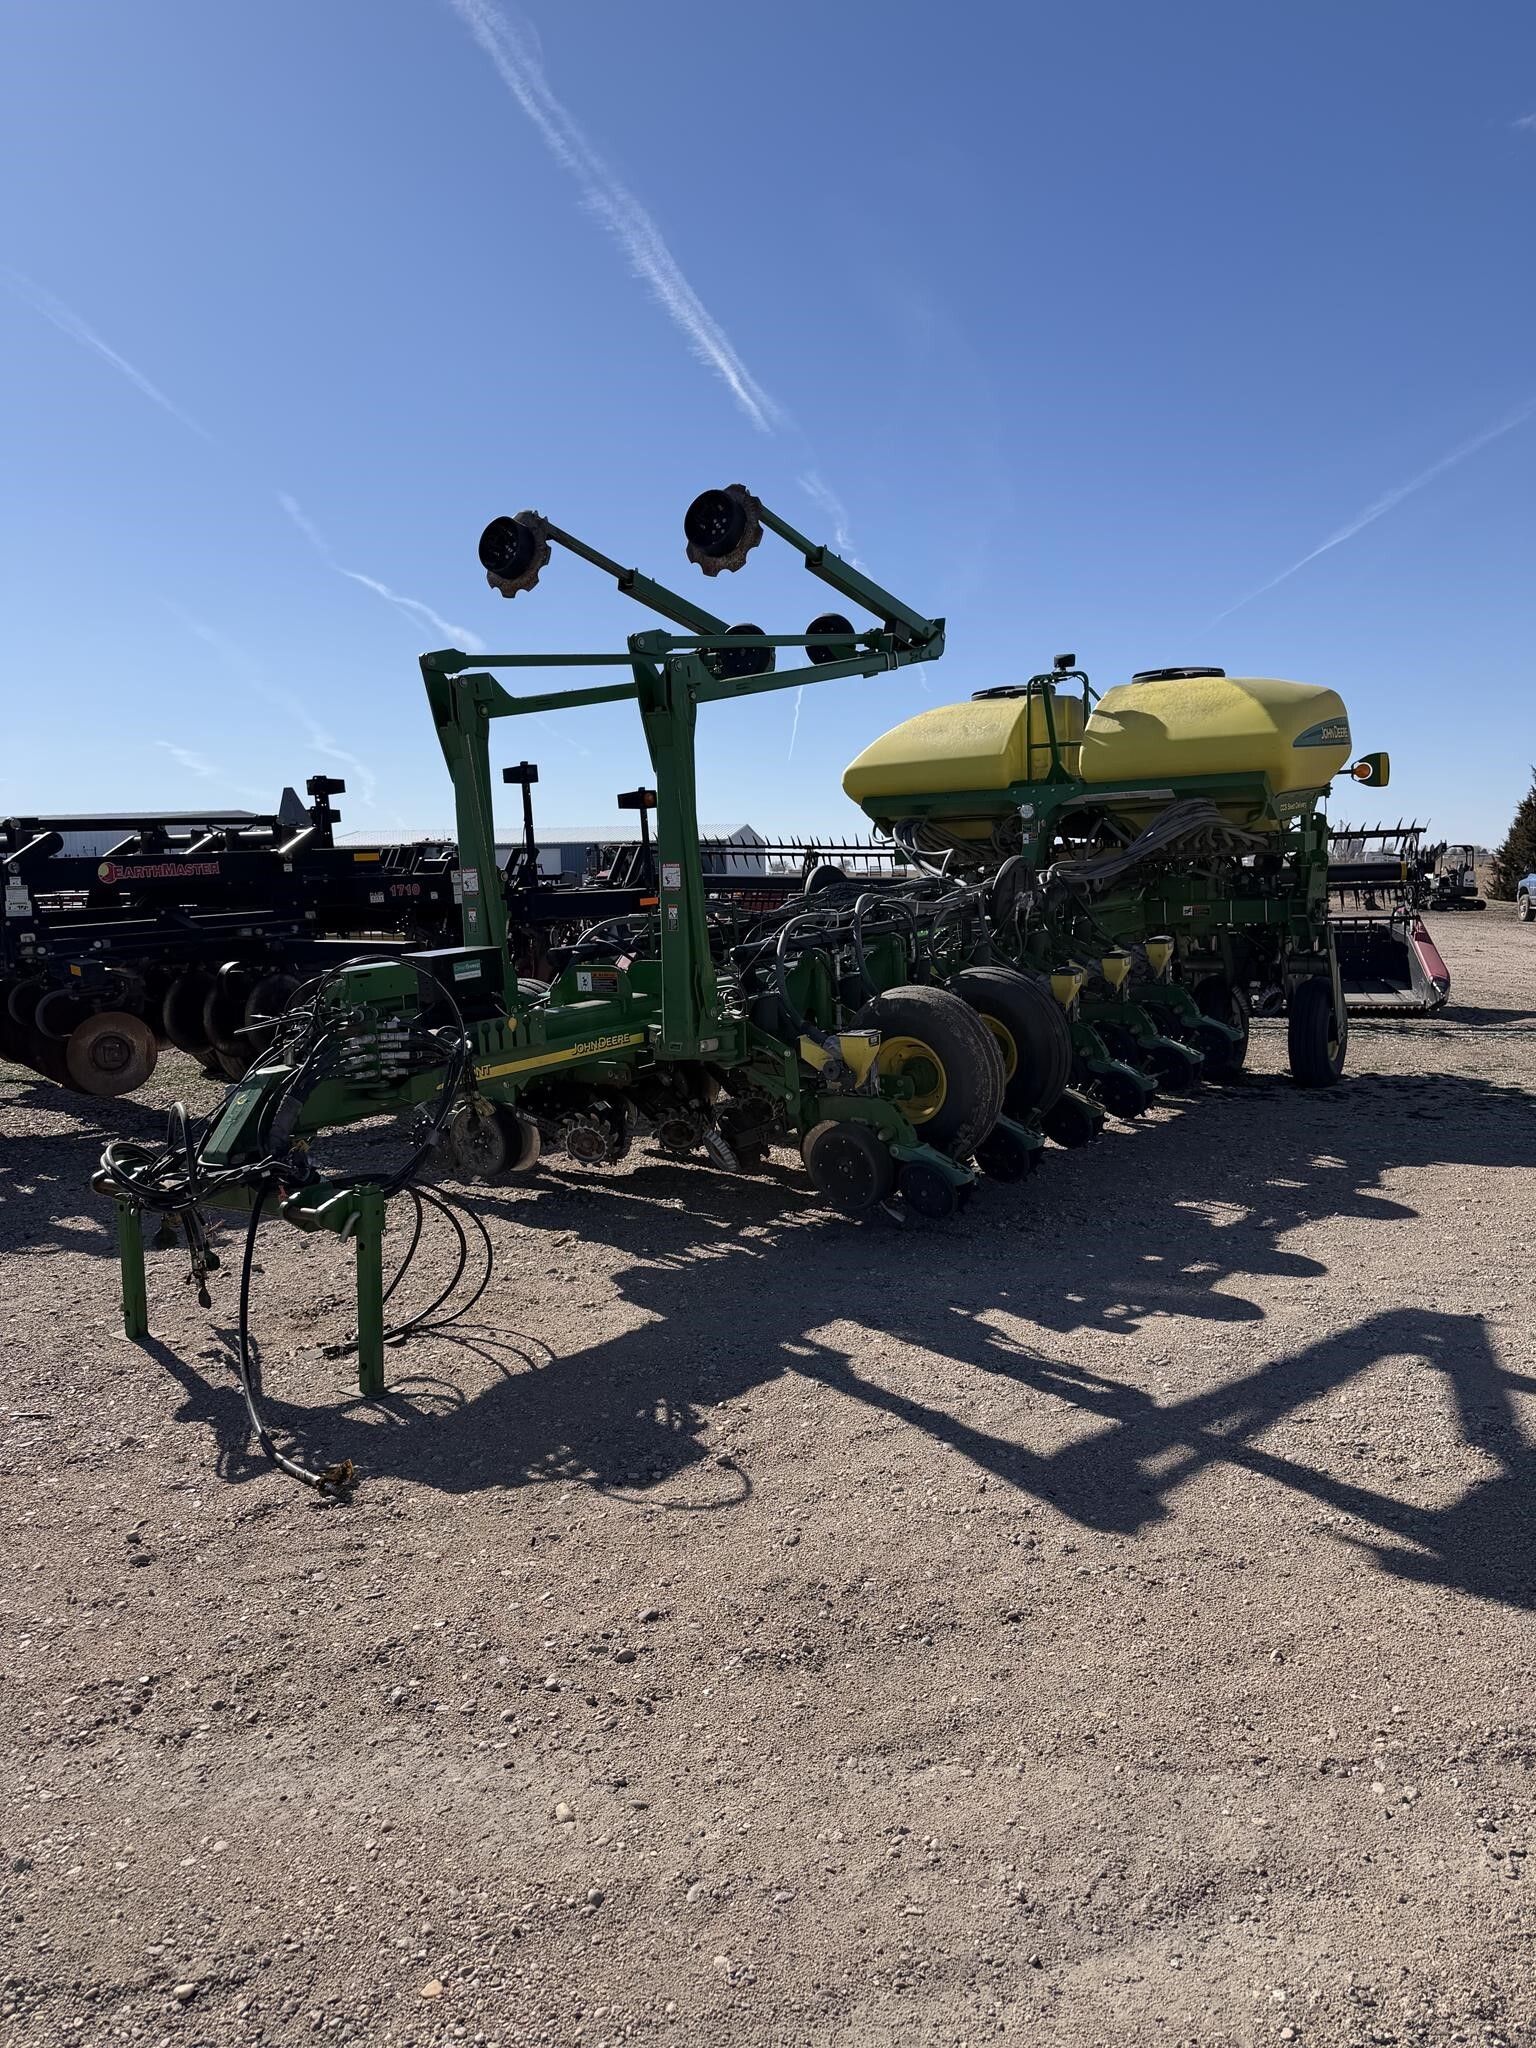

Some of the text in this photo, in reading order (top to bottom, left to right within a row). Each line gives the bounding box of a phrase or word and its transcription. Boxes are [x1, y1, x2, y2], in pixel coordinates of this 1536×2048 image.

[1321, 725, 1348, 739] JOHN DEERE
[390, 883, 421, 896] 1710
[572, 1033, 631, 1056] JOHN DEERE
